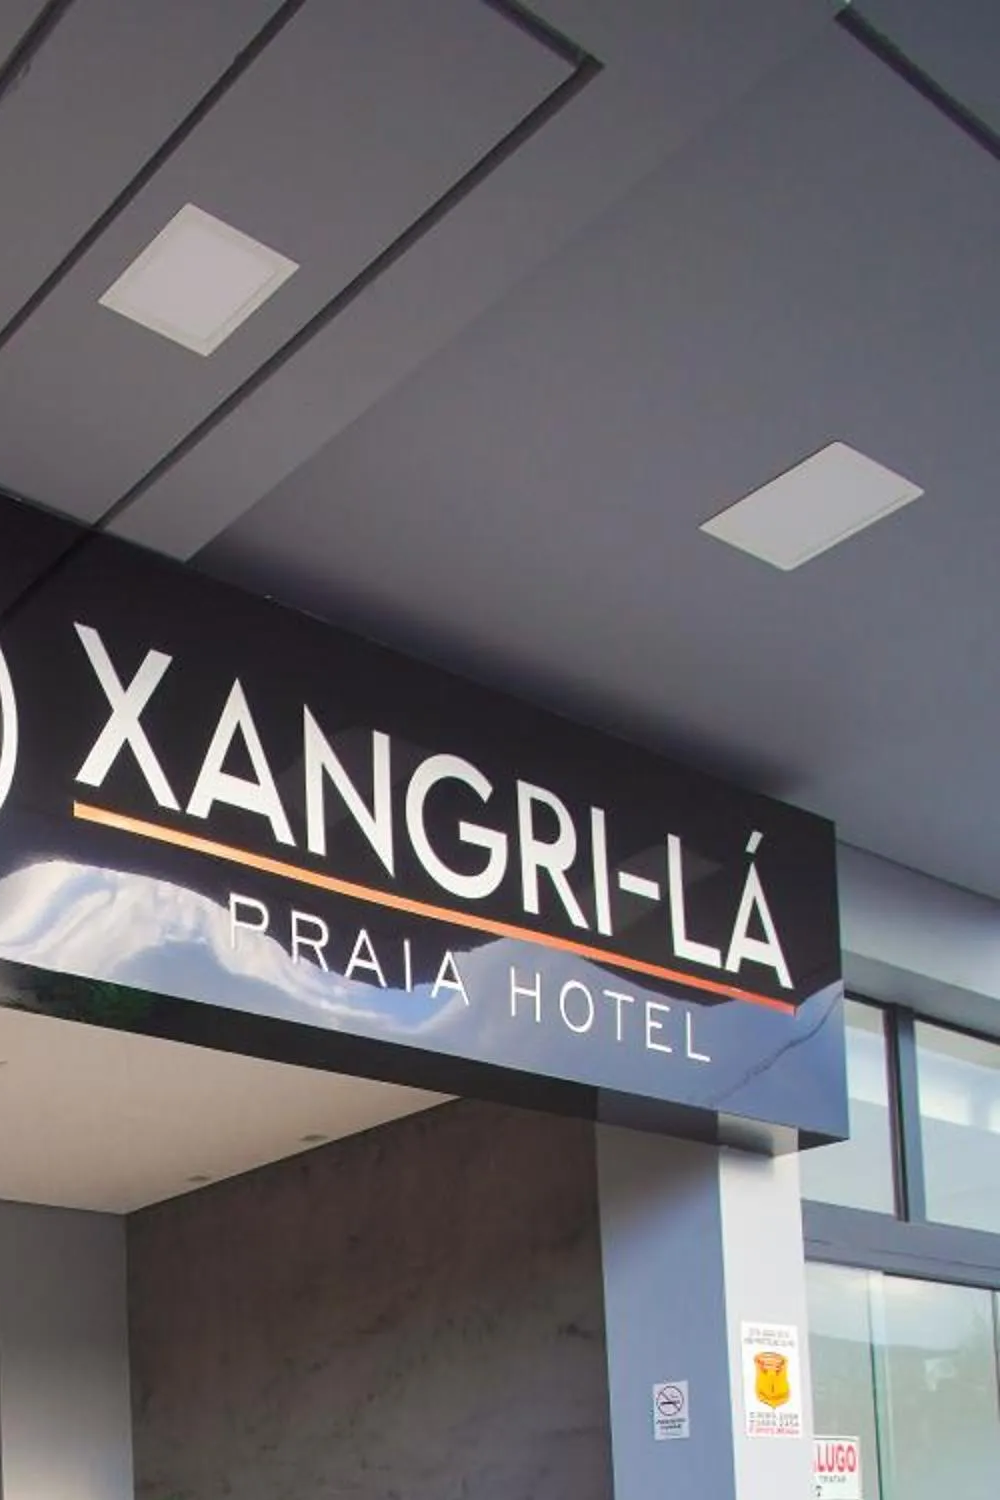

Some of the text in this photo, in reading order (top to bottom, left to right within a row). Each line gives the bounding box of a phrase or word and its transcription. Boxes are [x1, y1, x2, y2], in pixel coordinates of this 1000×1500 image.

[73, 622, 795, 989] XANGRI-LÁ
[228, 892, 711, 1063] PRAIA HOTEL
[813, 1443, 857, 1472] LUGO
